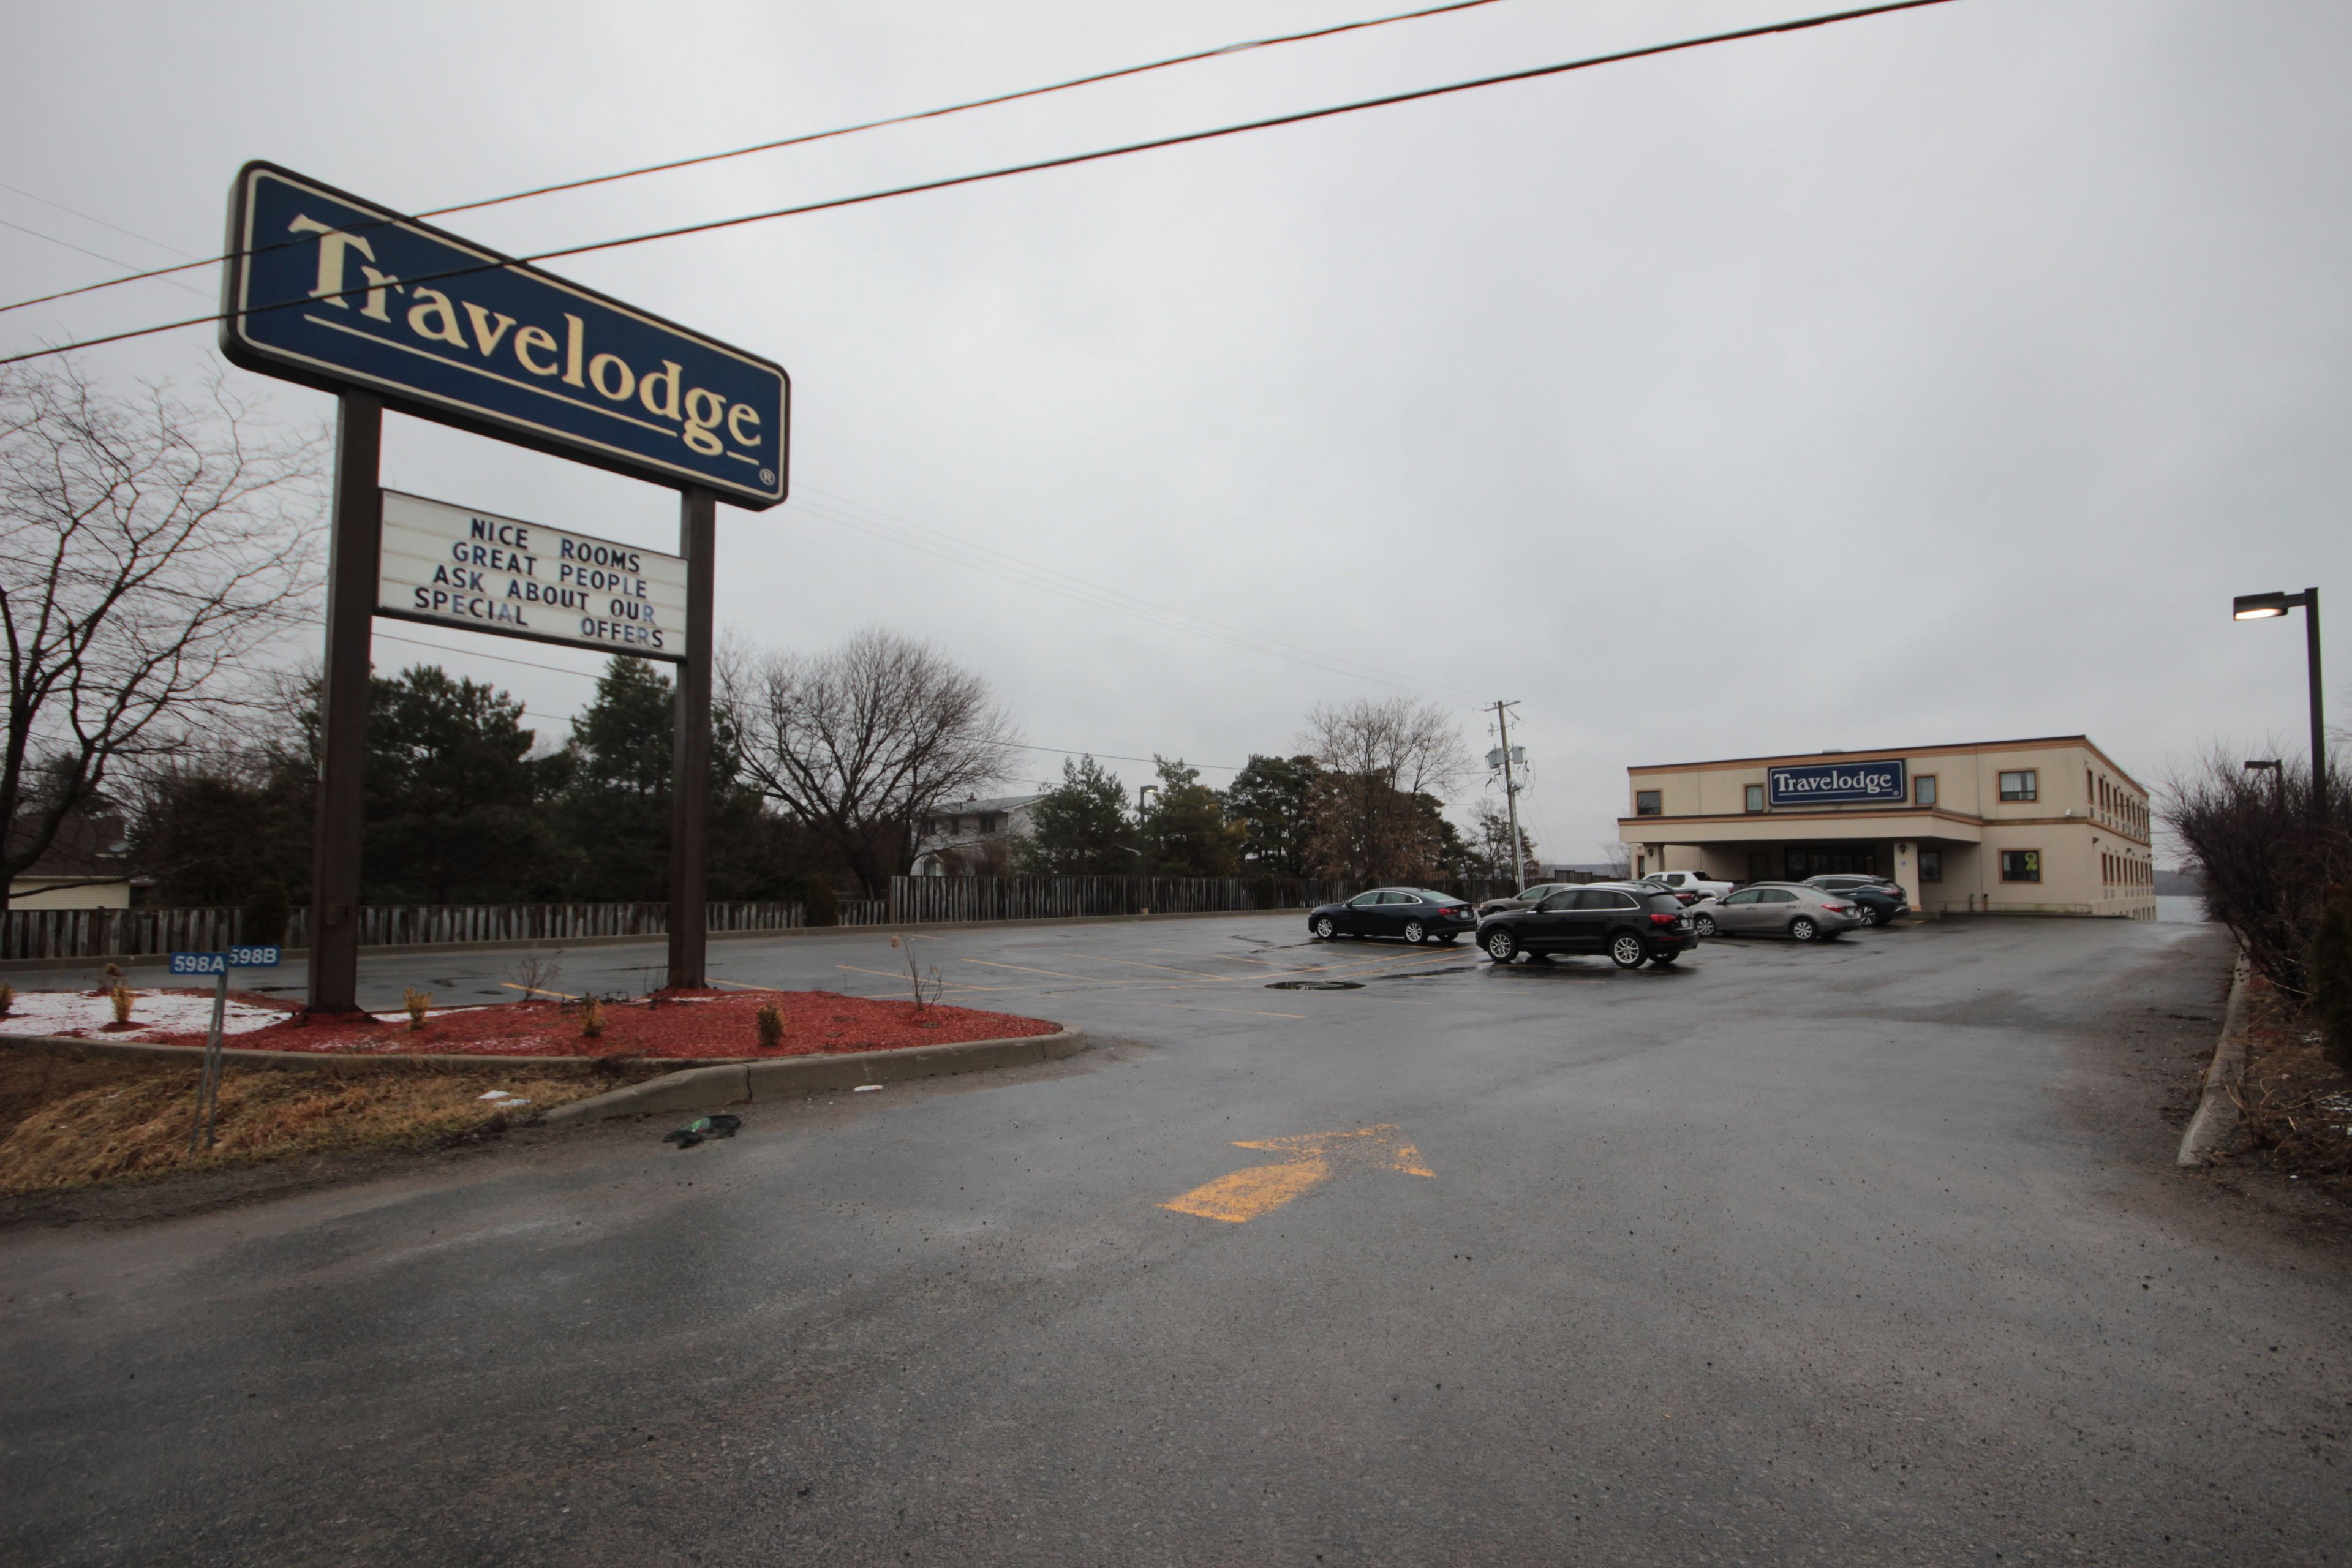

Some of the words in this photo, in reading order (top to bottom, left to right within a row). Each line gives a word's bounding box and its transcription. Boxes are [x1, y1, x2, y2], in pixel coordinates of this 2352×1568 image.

[288, 214, 761, 455] Travelodge
[453, 542, 537, 576] GREAT
[560, 564, 647, 598] PEOPLE
[472, 519, 528, 549] NICE
[560, 538, 640, 573] ROOMS
[415, 588, 528, 627] SPECIAL
[582, 617, 664, 649] OFFERS
[434, 565, 484, 592] ASK
[508, 580, 589, 611] ABOUT
[610, 598, 654, 624] OUR
[1774, 771, 1891, 793] Travelodge
[174, 956, 225, 972] 598A
[229, 948, 277, 964] 598B
